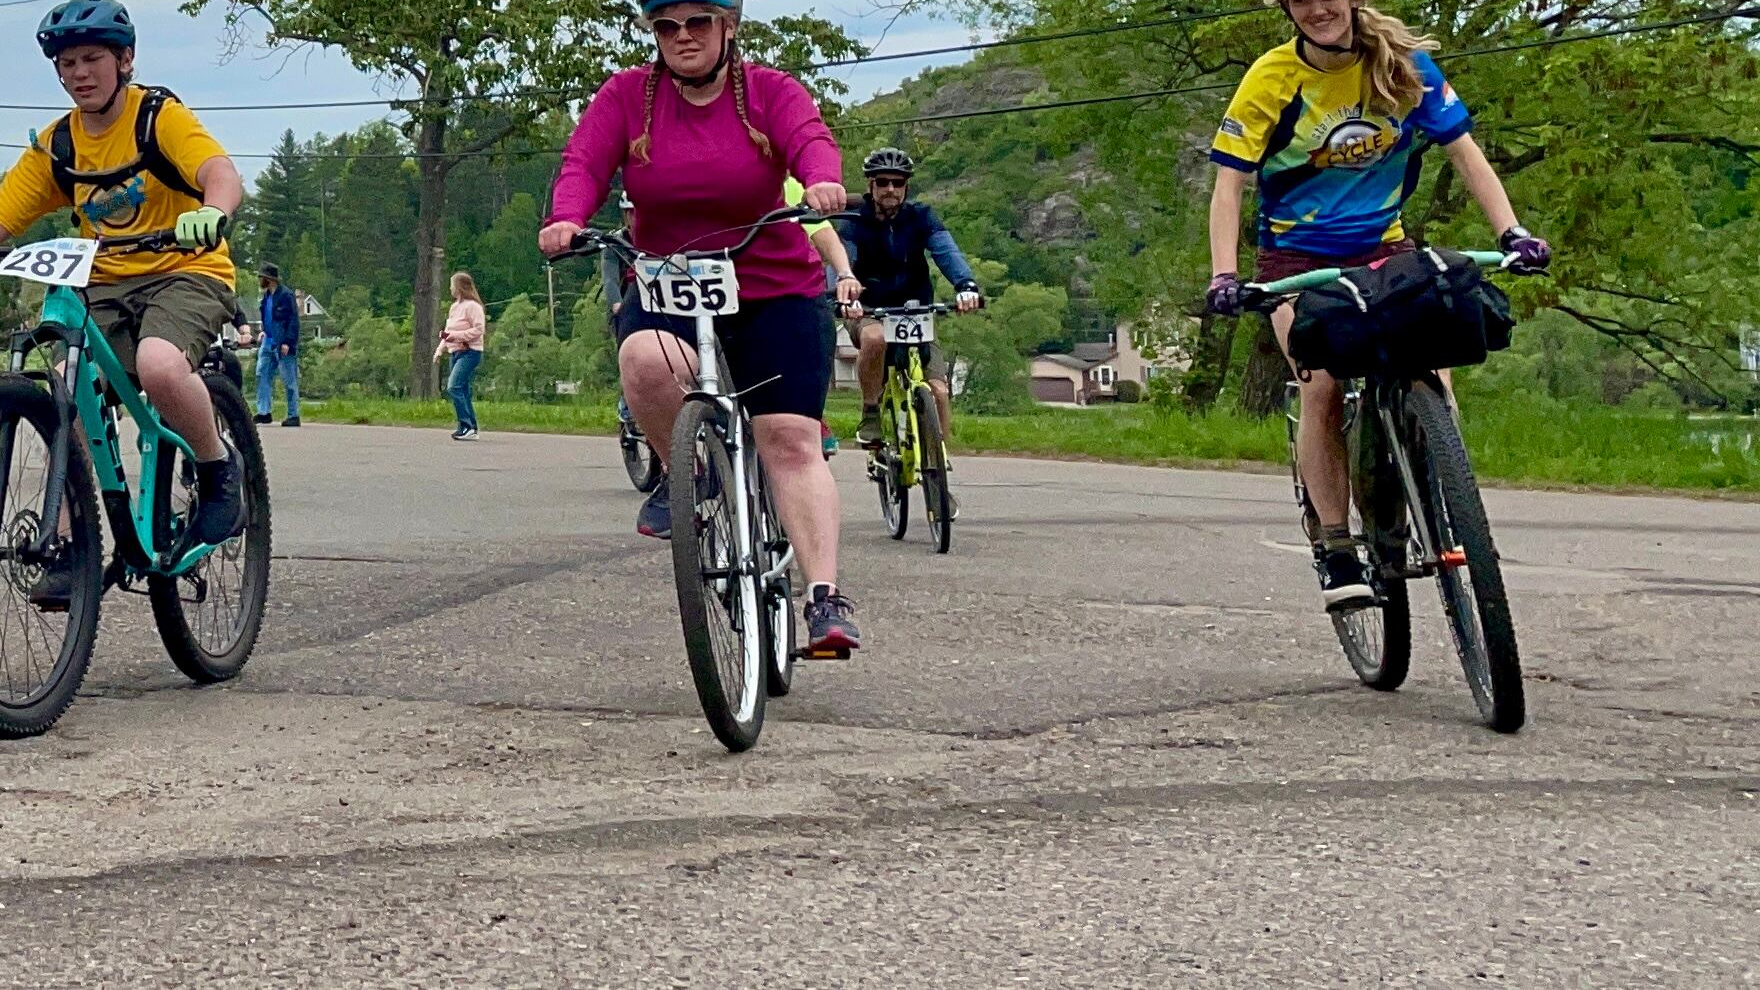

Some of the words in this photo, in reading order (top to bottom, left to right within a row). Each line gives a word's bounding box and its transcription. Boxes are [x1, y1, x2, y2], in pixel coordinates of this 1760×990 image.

[1328, 132, 1384, 165] CYCLE
[3, 249, 84, 278] 287
[648, 278, 726, 312] 155
[895, 323, 923, 340] 64
